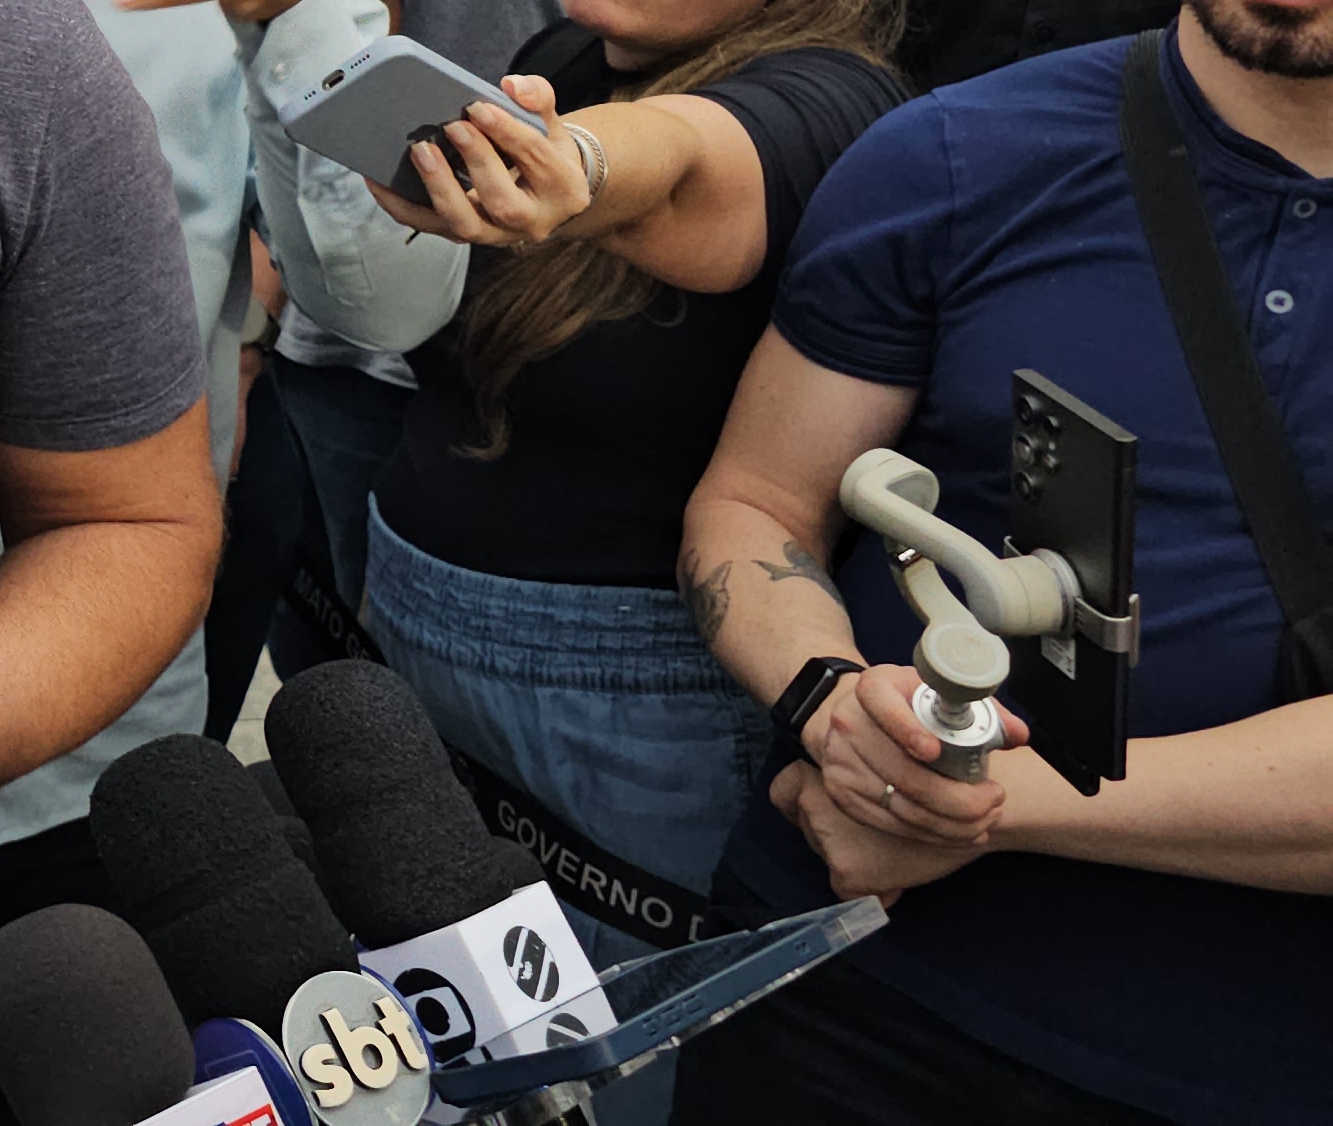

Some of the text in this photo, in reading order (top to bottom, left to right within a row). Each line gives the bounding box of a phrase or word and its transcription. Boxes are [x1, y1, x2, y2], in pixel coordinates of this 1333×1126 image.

[293, 567, 343, 641] MATO
[498, 799, 674, 929] GOVERNO
[301, 996, 428, 1108] sbt
